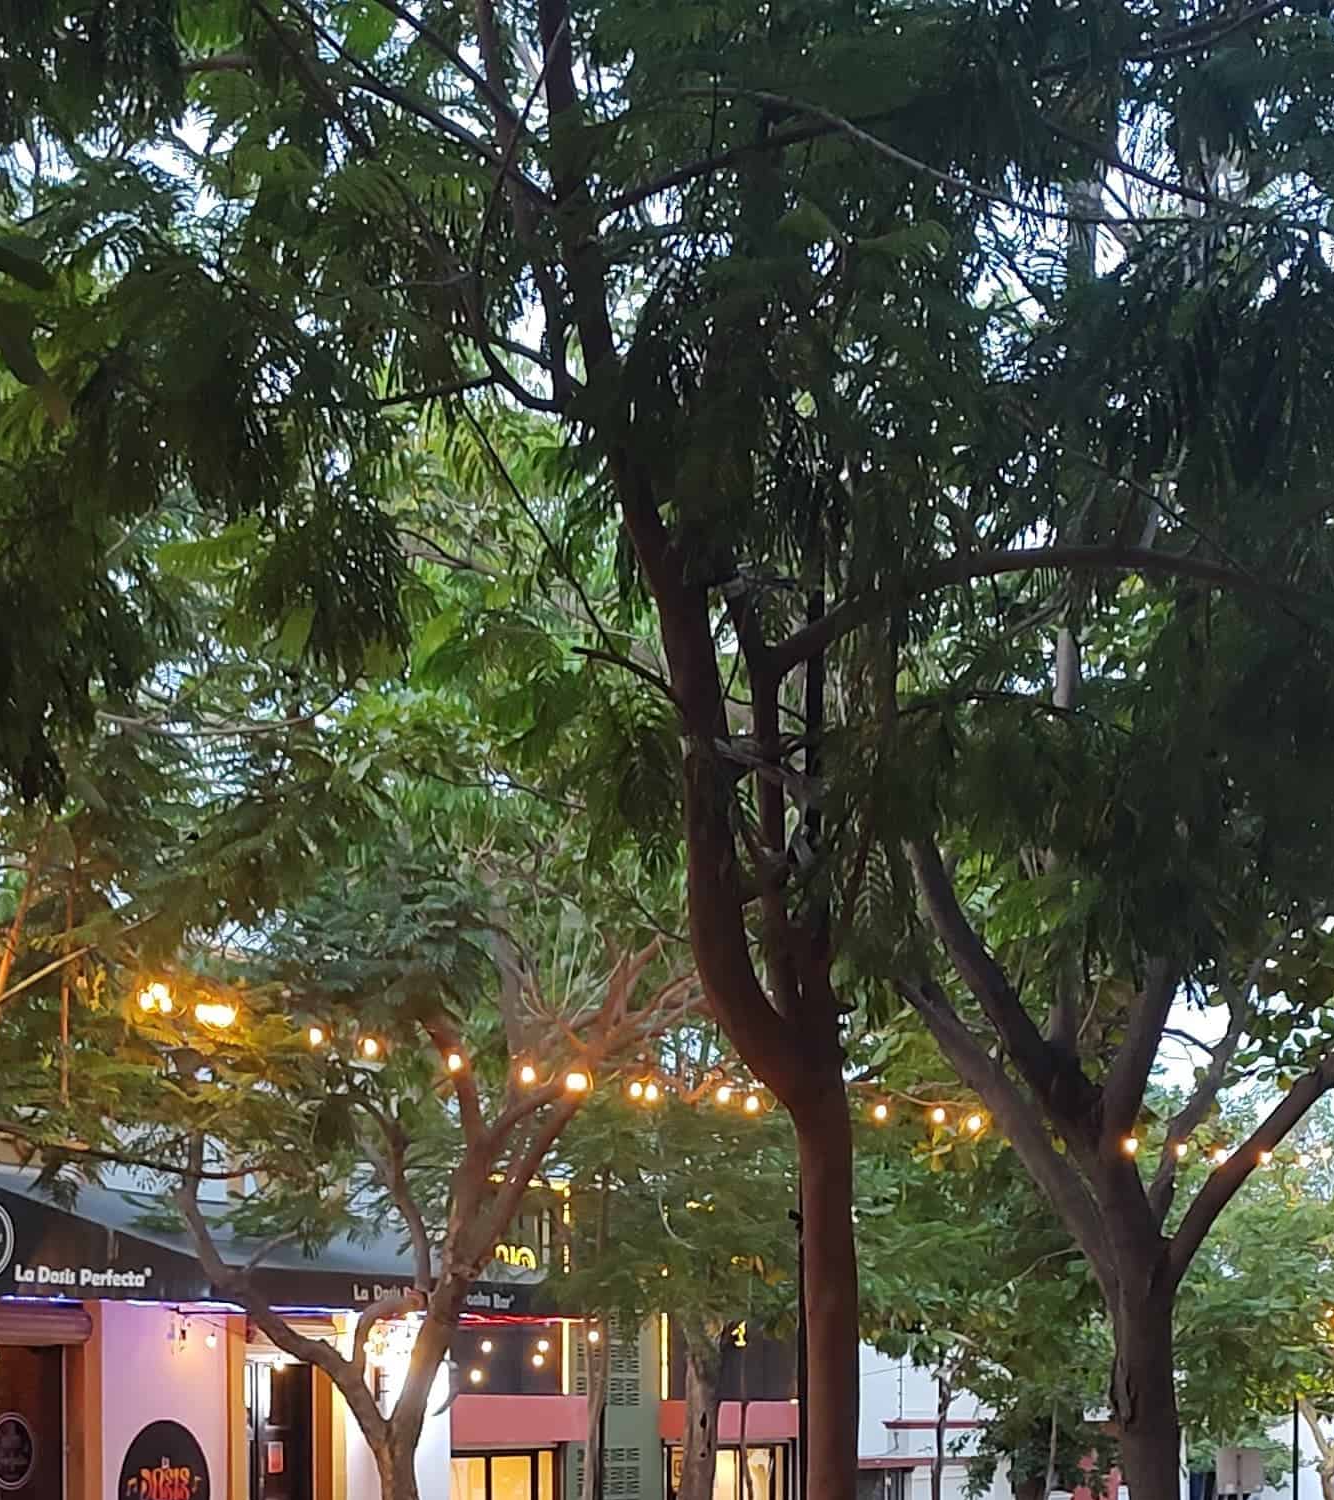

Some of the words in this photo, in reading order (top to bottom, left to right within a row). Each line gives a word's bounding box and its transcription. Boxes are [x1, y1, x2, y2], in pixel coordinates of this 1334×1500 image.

[14, 1264, 34, 1283] La
[38, 1265, 76, 1285] Dosis
[80, 1268, 146, 1288] Perfecta
[353, 1284, 368, 1301] La
